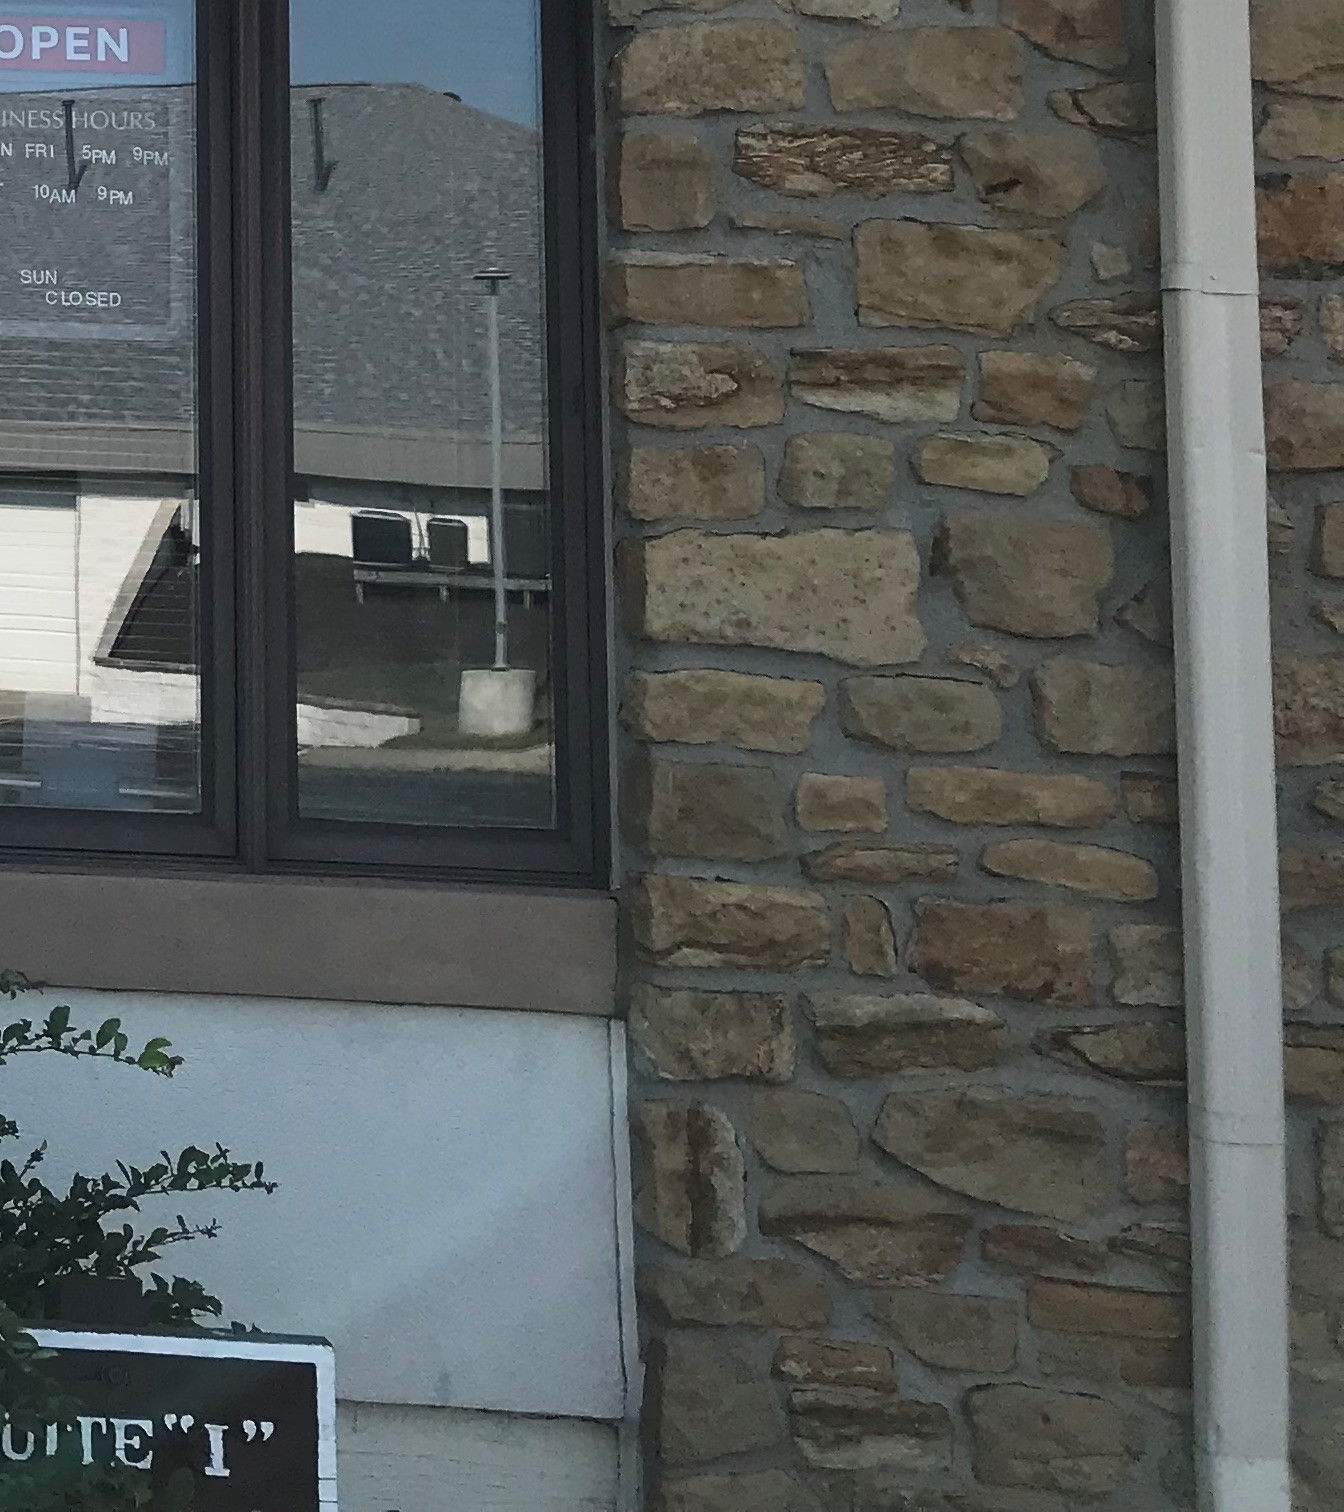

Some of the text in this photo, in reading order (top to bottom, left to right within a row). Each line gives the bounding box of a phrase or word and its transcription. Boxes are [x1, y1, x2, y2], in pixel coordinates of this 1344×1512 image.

[71, 109, 156, 131] HOURS
[24, 143, 55, 159] FRI
[20, 269, 58, 286] SUN
[45, 289, 122, 308] CLOSED
